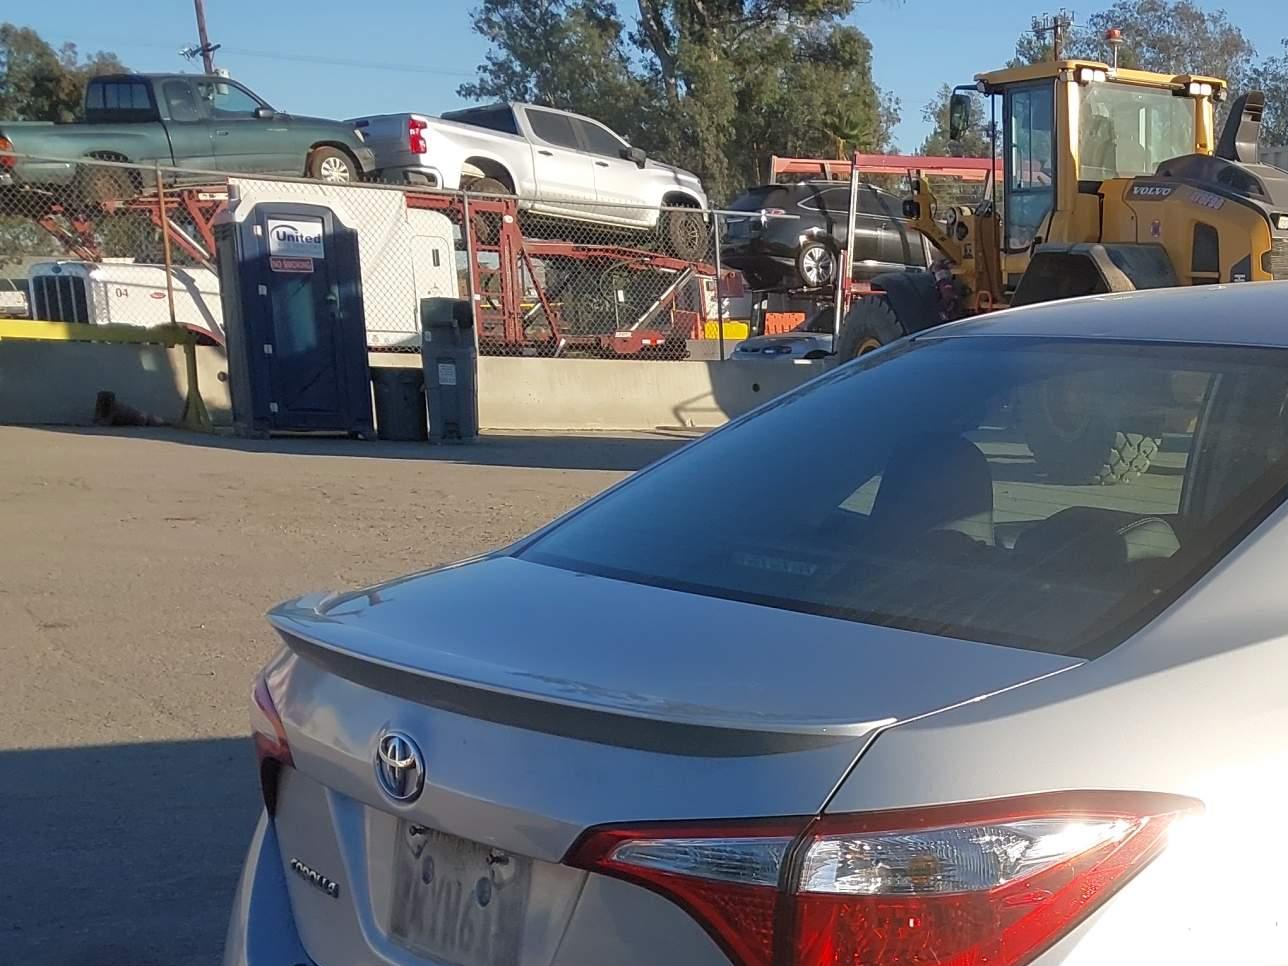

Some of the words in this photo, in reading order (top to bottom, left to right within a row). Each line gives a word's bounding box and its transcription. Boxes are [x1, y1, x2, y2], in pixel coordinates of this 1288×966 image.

[1133, 186, 1172, 196] VOLVO
[275, 230, 321, 244] United
[115, 287, 129, 298] 04
[290, 857, 339, 898] COROLLA
